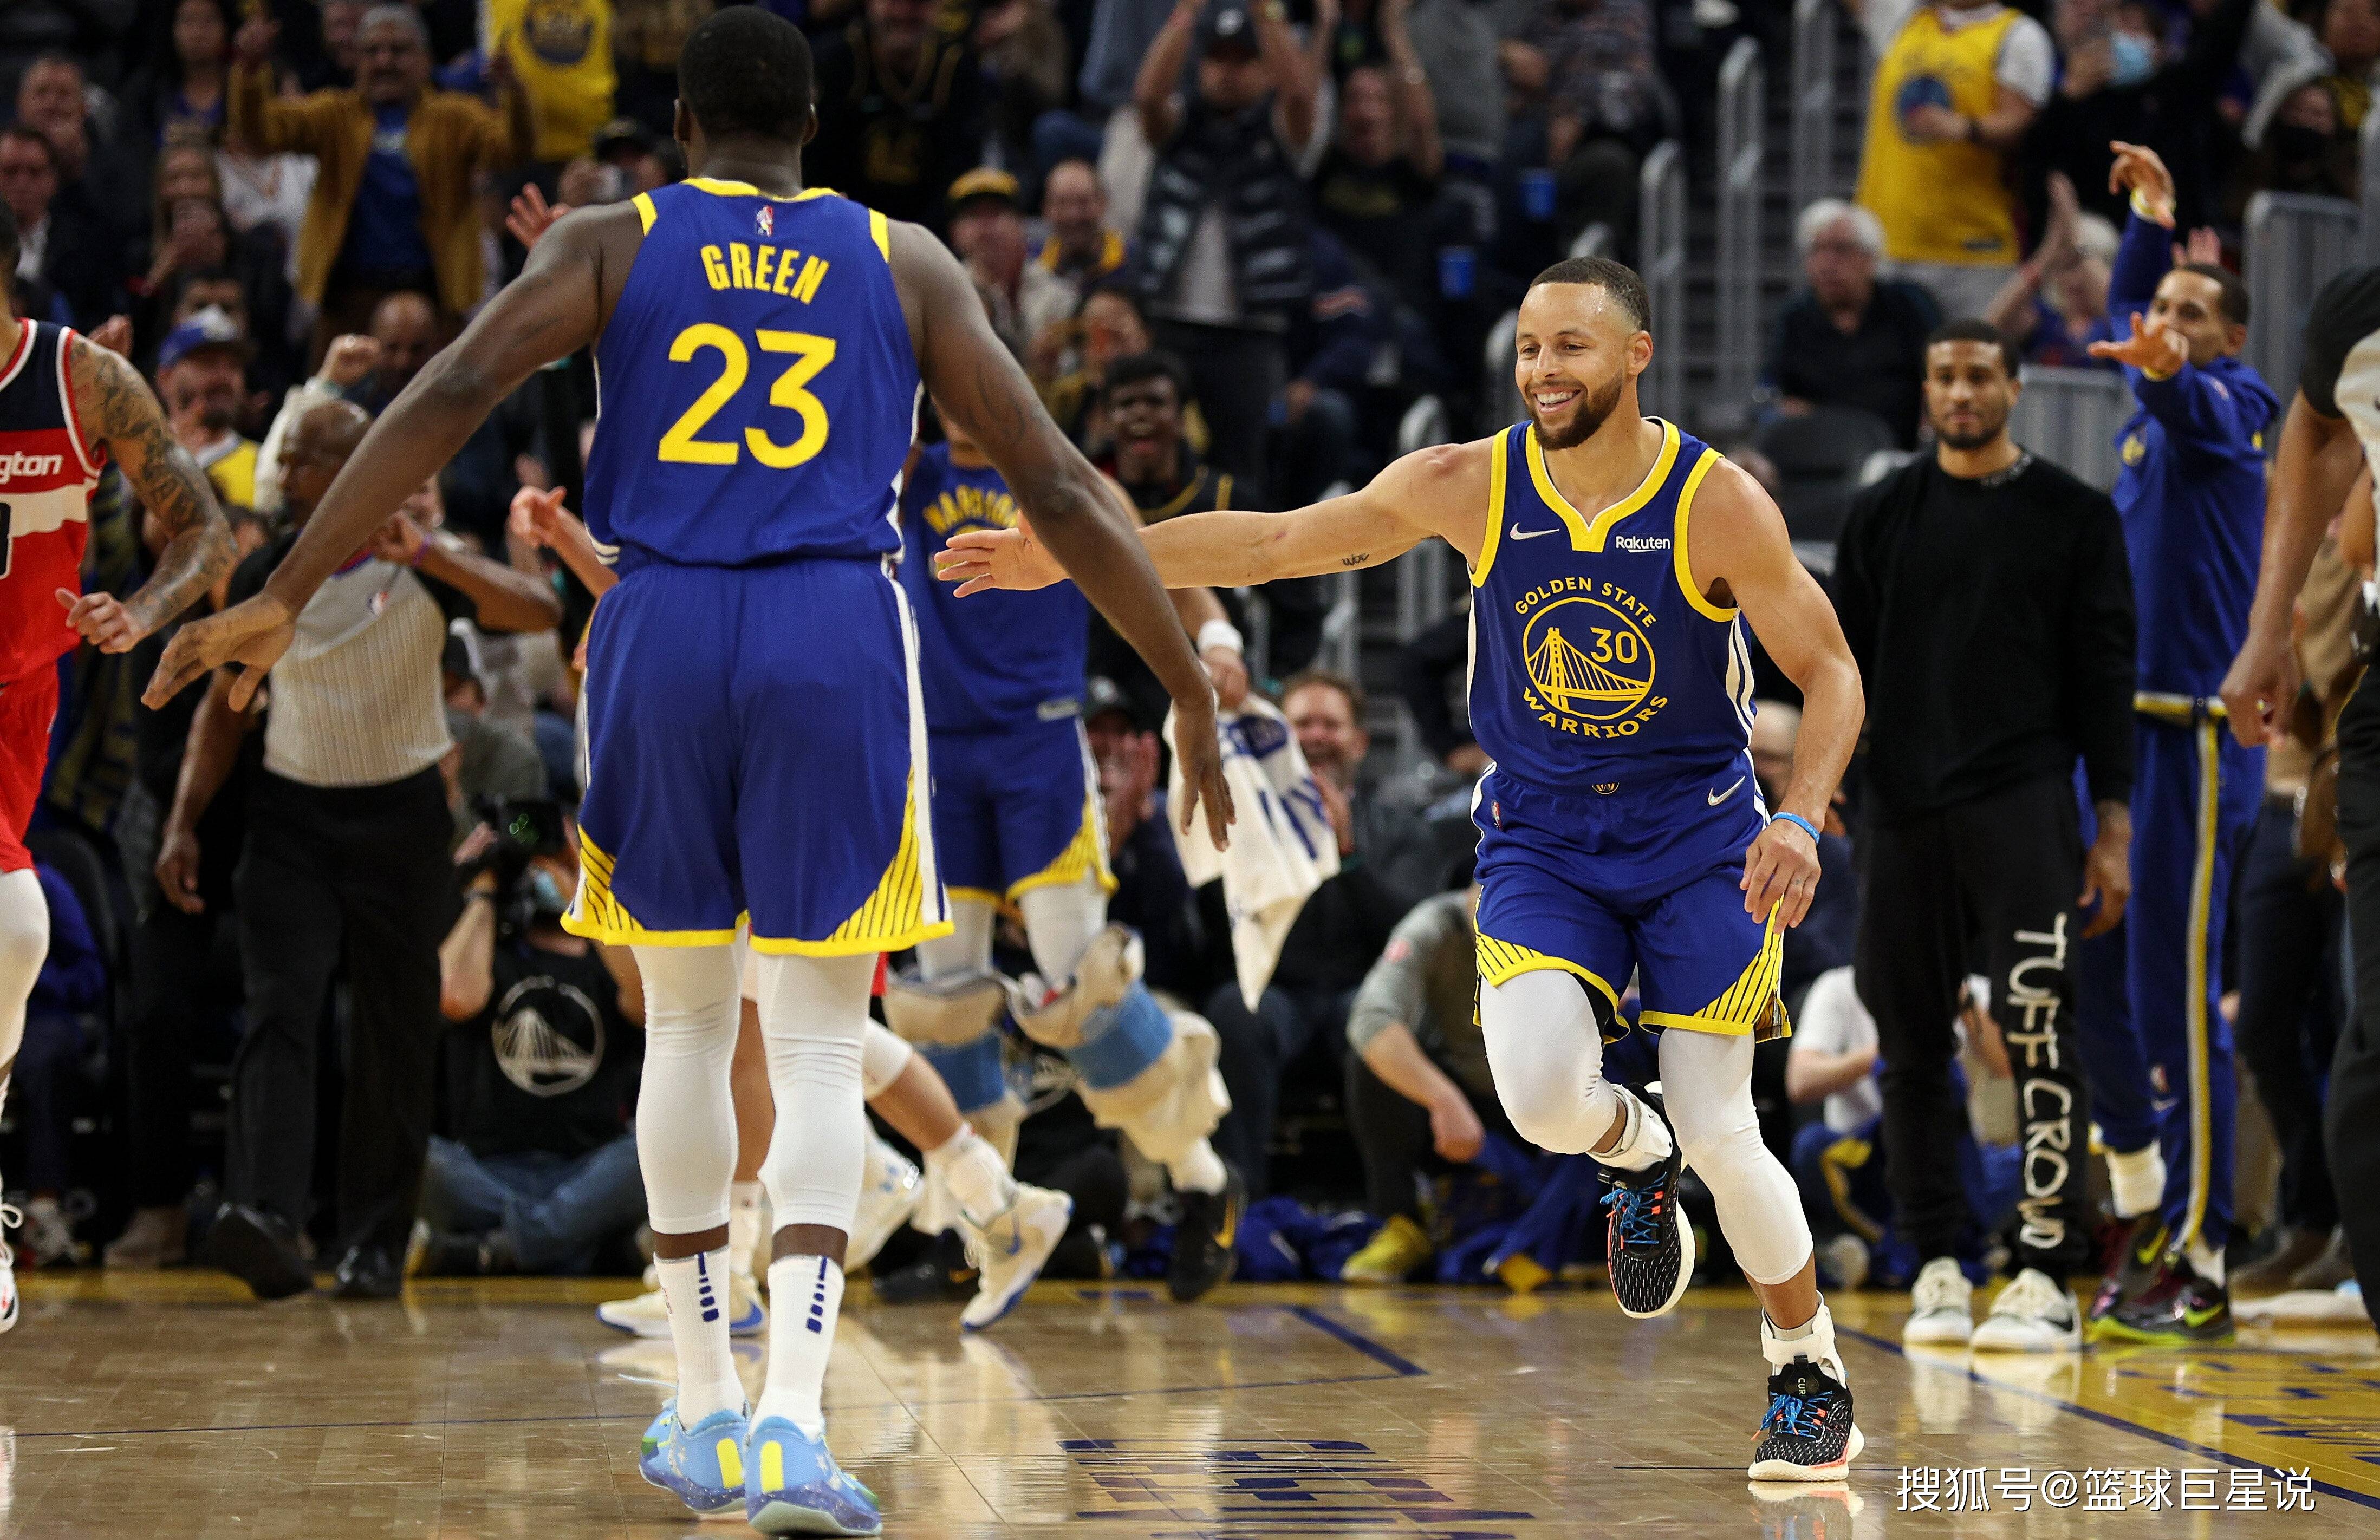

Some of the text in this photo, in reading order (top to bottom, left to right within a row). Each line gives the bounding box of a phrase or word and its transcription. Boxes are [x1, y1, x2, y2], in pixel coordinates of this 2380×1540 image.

[700, 242, 830, 305] GREEN
[658, 322, 837, 469] 23
[1616, 536, 1670, 550] Rakuten
[1515, 577, 1656, 628] GOLDEN STATE
[1590, 627, 1638, 664] 30
[1523, 687, 1668, 738] WARRIORS
[2006, 911, 2068, 1065] TUFF
